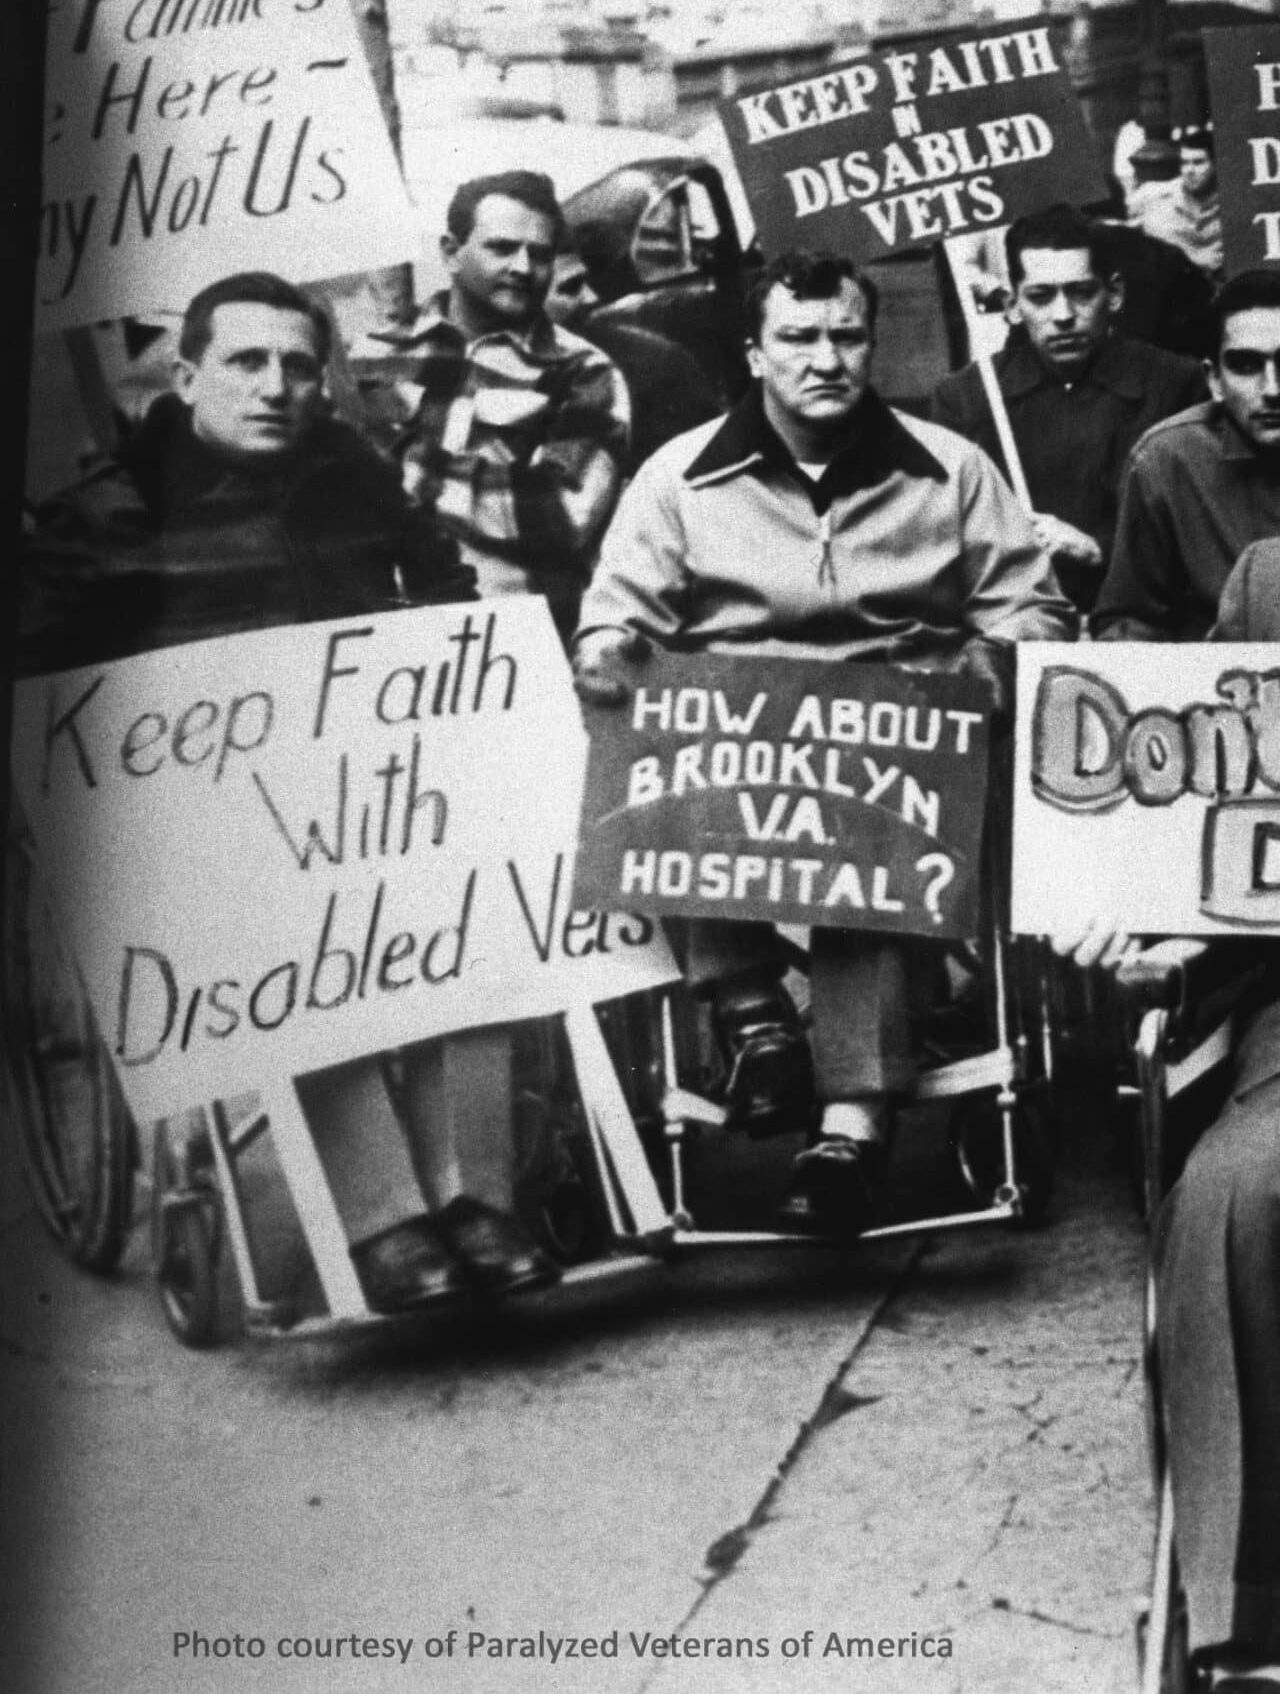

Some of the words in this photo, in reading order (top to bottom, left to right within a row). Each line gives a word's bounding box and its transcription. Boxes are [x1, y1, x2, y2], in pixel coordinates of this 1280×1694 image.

[91, 55, 278, 140] Here
[737, 65, 879, 145] KEEP
[884, 27, 1060, 103] FAITH
[110, 145, 239, 247] Not
[243, 115, 348, 218] Us
[784, 113, 1054, 219] DISABLED
[860, 186, 1005, 247] VETS
[42, 674, 276, 790] Keep
[313, 612, 518, 740] Faith
[631, 687, 768, 736] HOW
[788, 695, 983, 754] ABOUT
[252, 733, 450, 870] With
[627, 740, 941, 838] BROOKLYN
[115, 868, 477, 1066] Disabled
